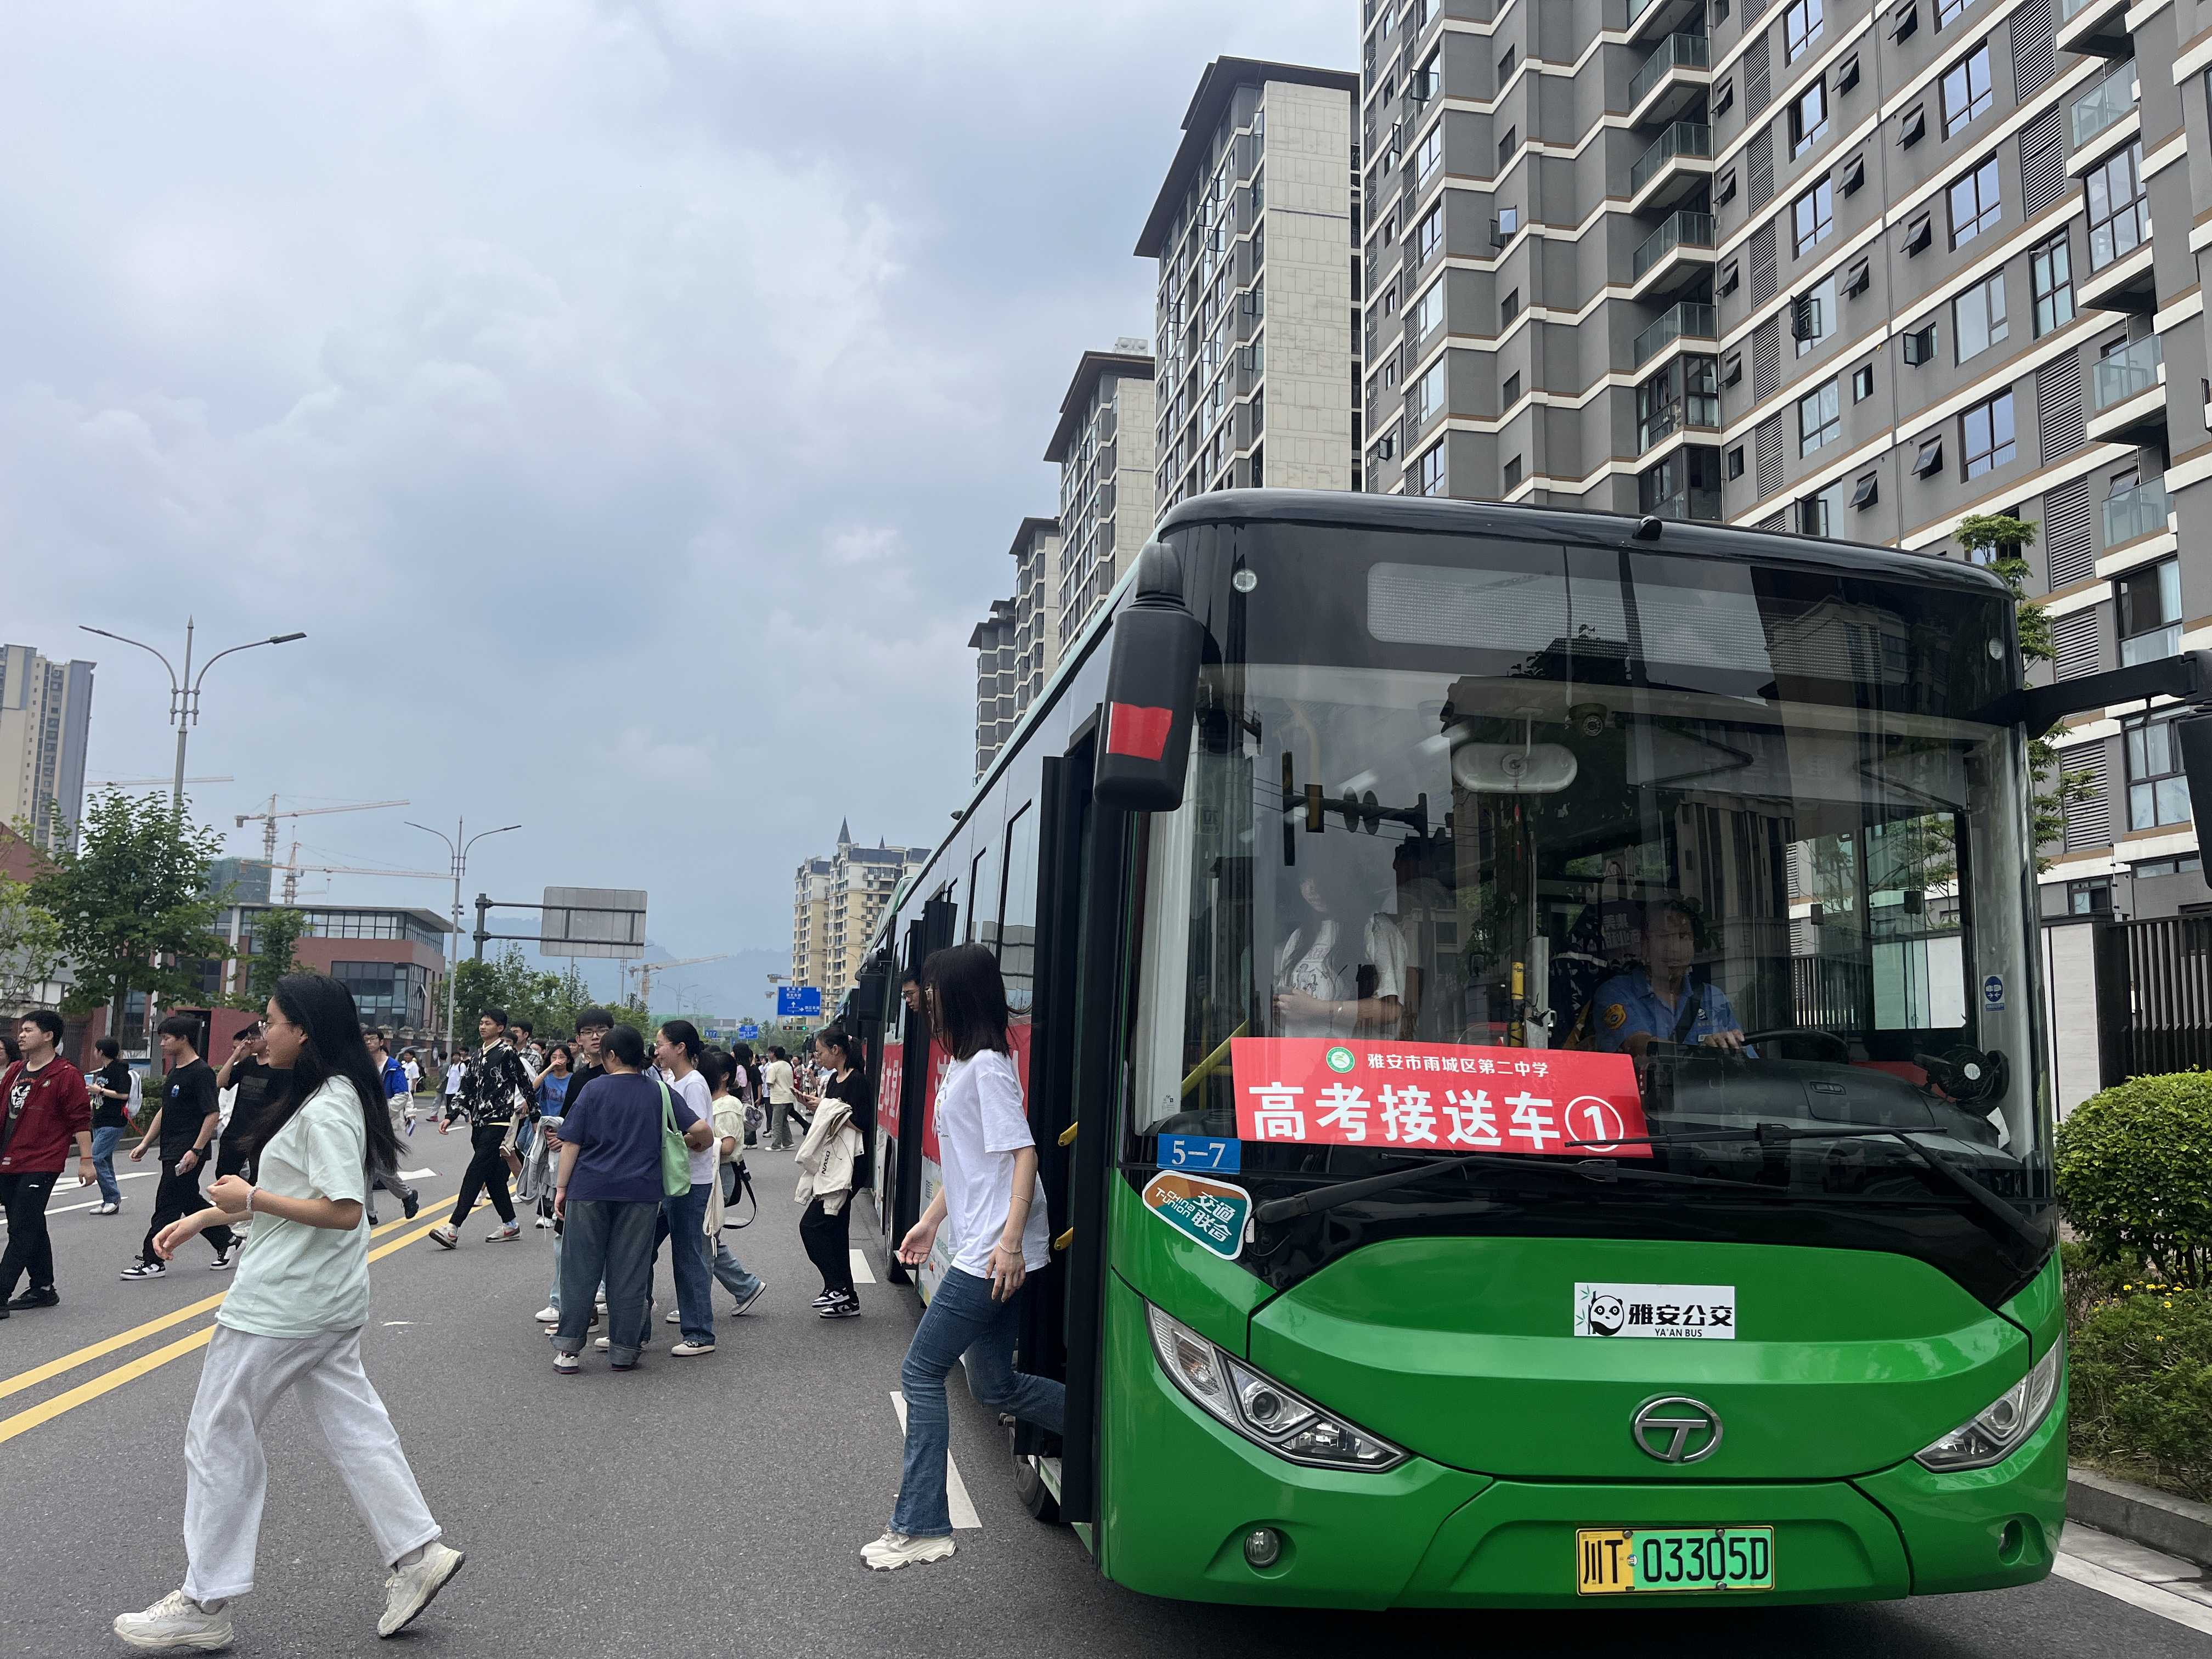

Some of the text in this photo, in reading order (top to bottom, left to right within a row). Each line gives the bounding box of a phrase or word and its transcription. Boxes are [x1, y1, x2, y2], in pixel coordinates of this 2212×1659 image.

[1367, 1053, 1549, 1078] 雅安市雨城区第二中学
[1192, 1191, 1236, 1223] 交通
[1191, 1209, 1232, 1242] 联合
[1628, 1304, 1733, 1327] 雅安公交
[1655, 1328, 1702, 1338] YA'AN BUS
